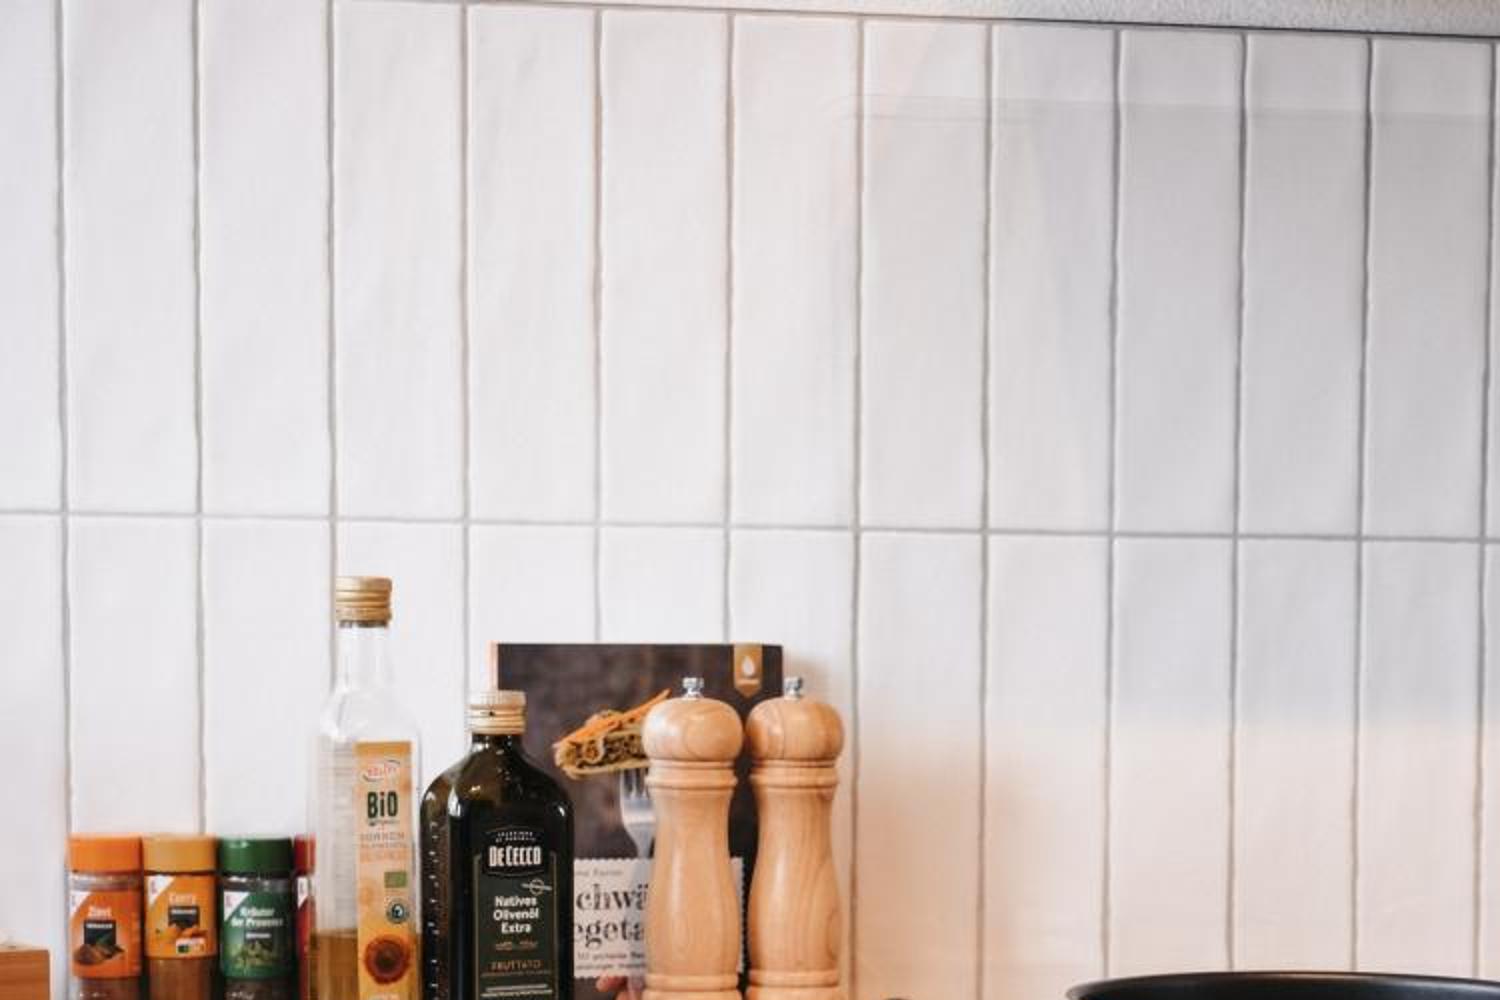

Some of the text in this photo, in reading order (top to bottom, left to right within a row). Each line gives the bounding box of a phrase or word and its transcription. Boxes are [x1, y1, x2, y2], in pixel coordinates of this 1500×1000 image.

[495, 895, 537, 907] Natives
[493, 908, 540, 921] Olivenöl
[501, 921, 532, 934] Extra
